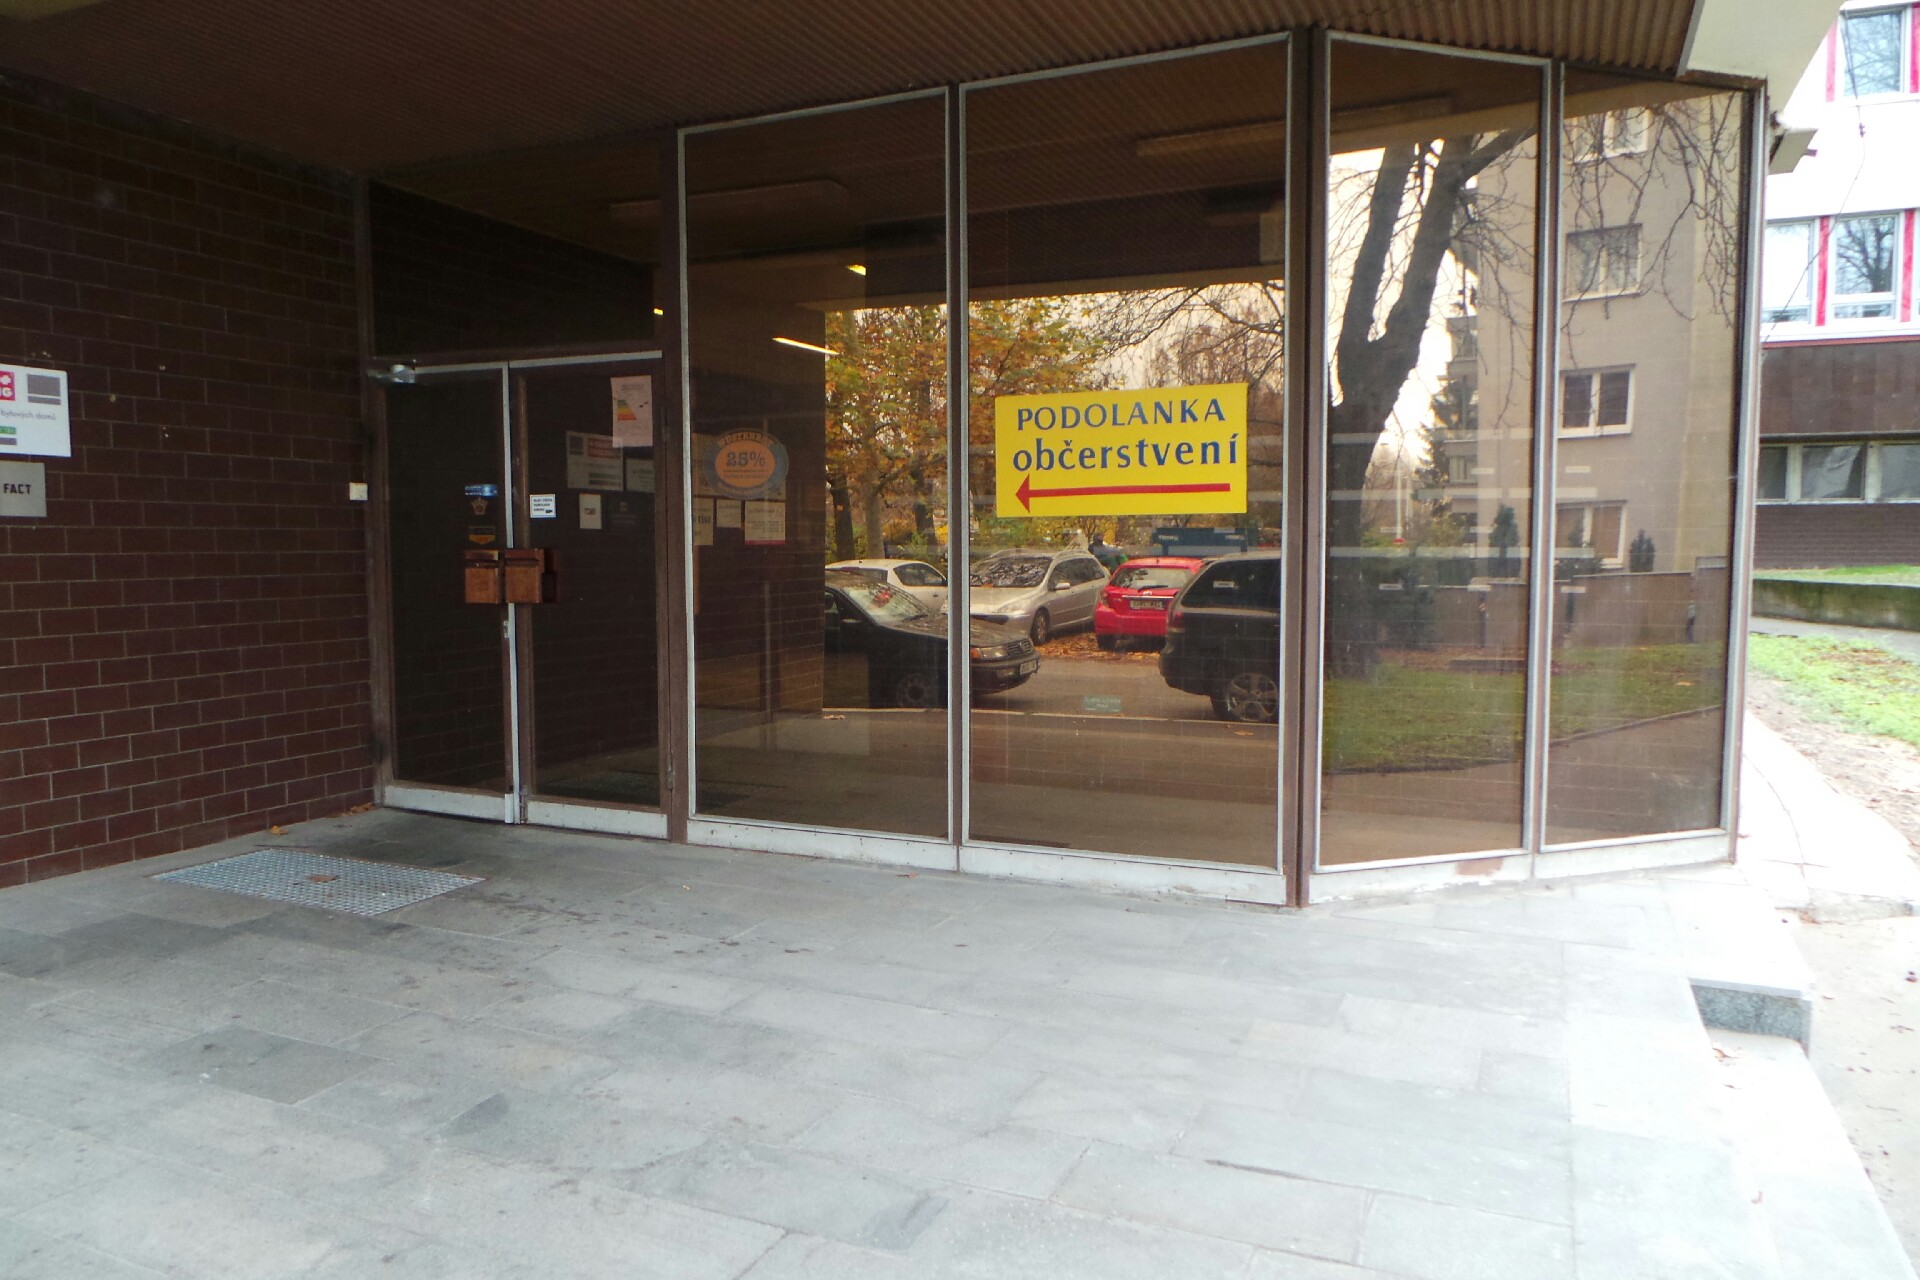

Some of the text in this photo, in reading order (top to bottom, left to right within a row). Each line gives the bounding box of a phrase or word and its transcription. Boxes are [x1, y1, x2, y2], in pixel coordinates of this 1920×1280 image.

[1017, 398, 1226, 431] PODOLANKA
[726, 451, 766, 467] 25%
[1013, 433, 1239, 472] občerstvení
[3, 483, 32, 495] FACT
